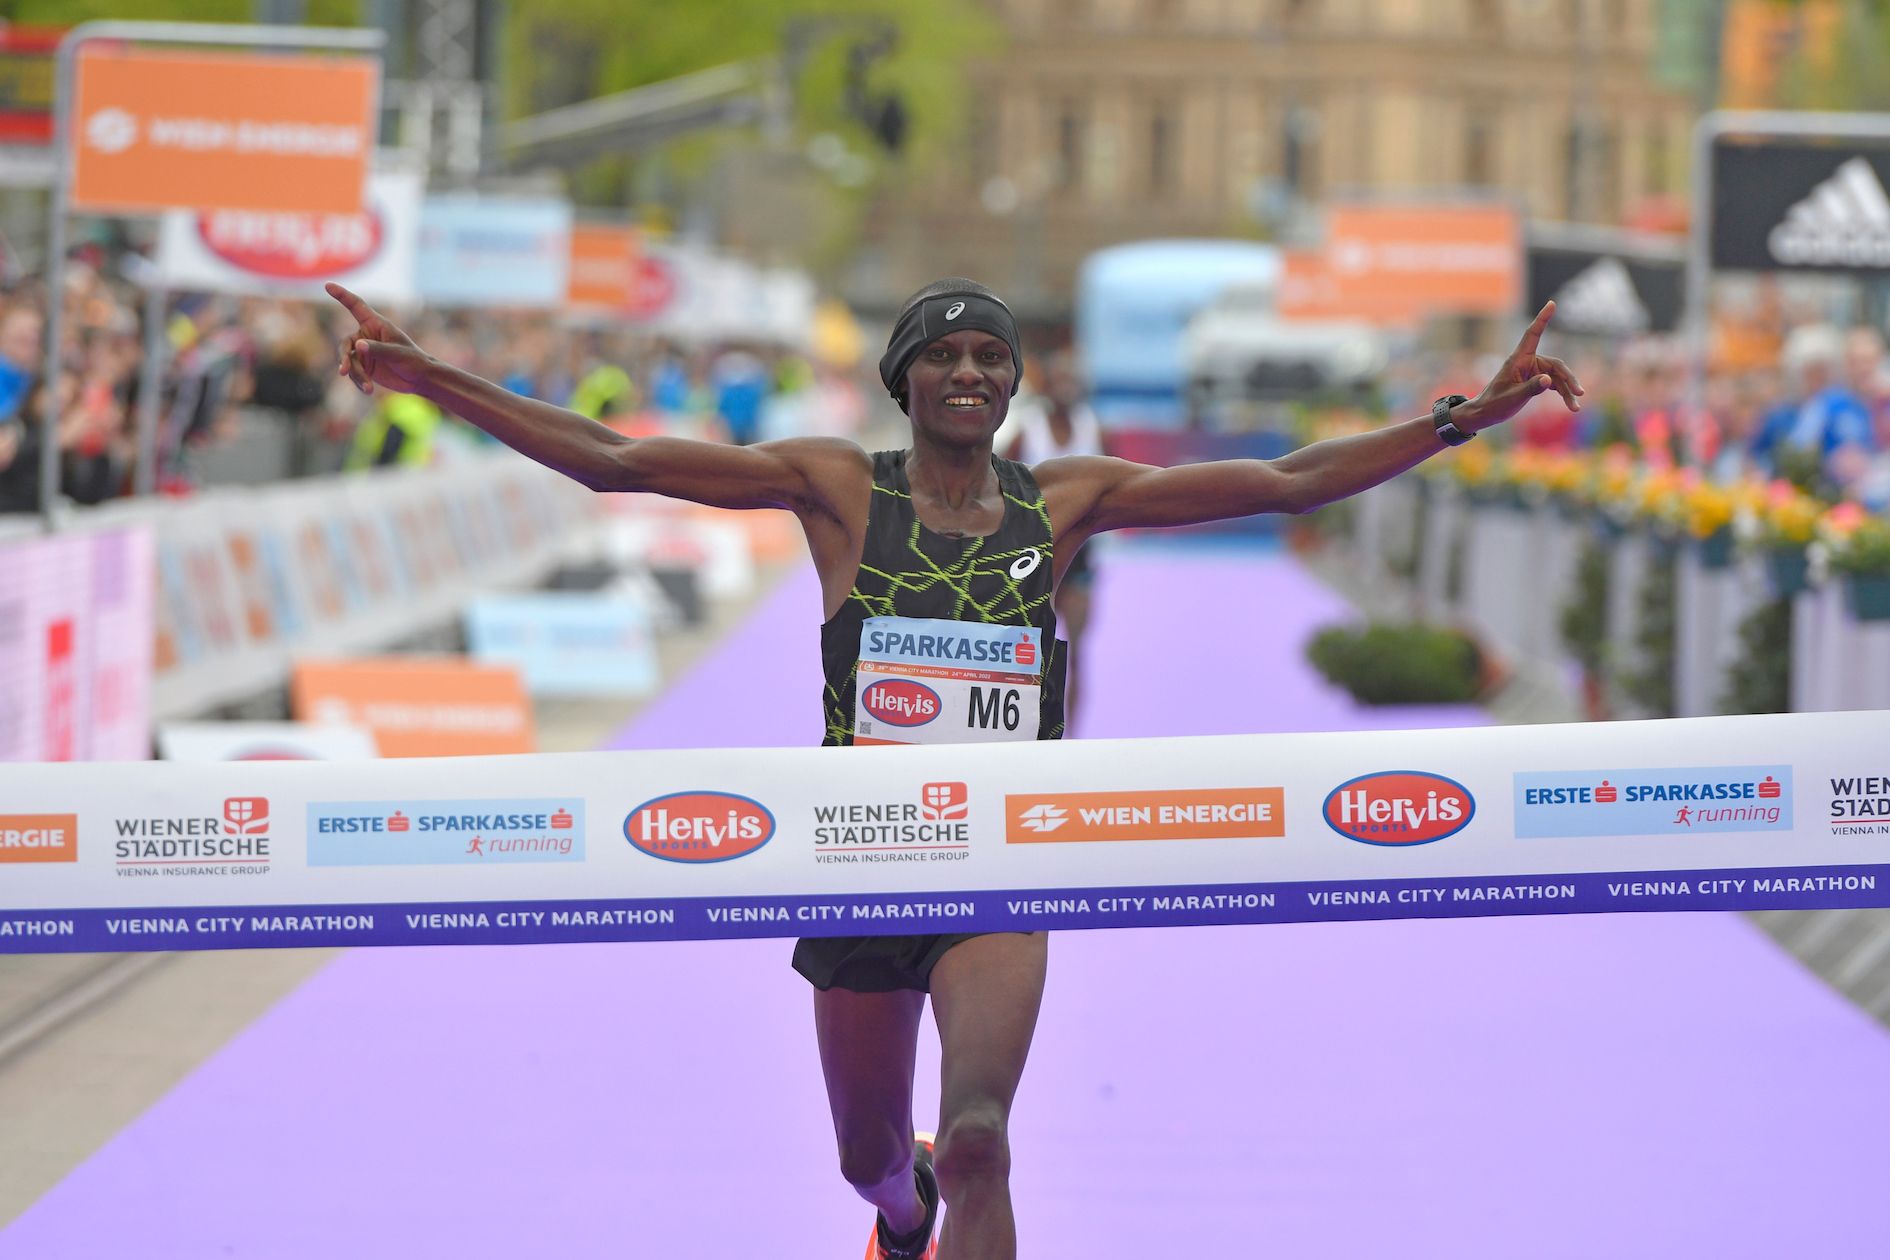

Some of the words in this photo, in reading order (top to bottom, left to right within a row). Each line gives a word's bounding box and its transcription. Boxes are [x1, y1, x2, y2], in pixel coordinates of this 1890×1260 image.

[869, 630, 1013, 664] SPARKASSE
[870, 686, 935, 718] Hervis
[967, 686, 1021, 732] M6
[1525, 787, 1592, 805] ERSTE
[1625, 782, 1755, 802] SPARKASSE
[814, 804, 918, 824] WIENER
[1077, 805, 1151, 827] WIEN
[1158, 803, 1272, 825] ENERGIE
[1340, 790, 1462, 829] Hervis
[1697, 804, 1780, 823] running
[115, 817, 220, 837] WIENER
[318, 816, 385, 834] ERSTE
[418, 813, 548, 832] SPARKASSE
[641, 808, 763, 847] Hervis
[814, 823, 970, 845] STÄDTISCHE
[1351, 824, 1408, 833] SPORTS
[1831, 826, 1875, 836] VIENNA
[0, 828, 65, 849] RGIE
[115, 838, 271, 858] STÄDTISCHE
[489, 835, 573, 855] running
[815, 853, 859, 864] VIENNA
[860, 852, 927, 863] INSURANCE
[929, 851, 970, 862] GROUP
[116, 867, 160, 878] VIENNA
[162, 866, 229, 877] INSURANCE
[231, 865, 271, 876] GROUP
[1307, 890, 1391, 906] VIENNA
[1397, 888, 1447, 903] CITY
[1453, 884, 1576, 902] MARATHON
[1607, 881, 1692, 897] VIENNA
[1697, 879, 1747, 895] CITY
[1753, 875, 1877, 893] MARATHON
[707, 906, 791, 923] VIENNA
[797, 905, 846, 921] CITY
[852, 902, 976, 919] MARATHON
[1007, 899, 1091, 915] VIENNA
[1097, 897, 1146, 913] CITY
[1153, 893, 1276, 911] MARATHON
[0, 919, 75, 937] ATHON
[106, 918, 190, 935] VIENNA
[195, 917, 246, 933] CITY
[251, 915, 375, 933] MARATHON
[405, 912, 490, 930] VIENNA
[496, 911, 545, 928] CITY
[552, 908, 675, 927] MARATHON
